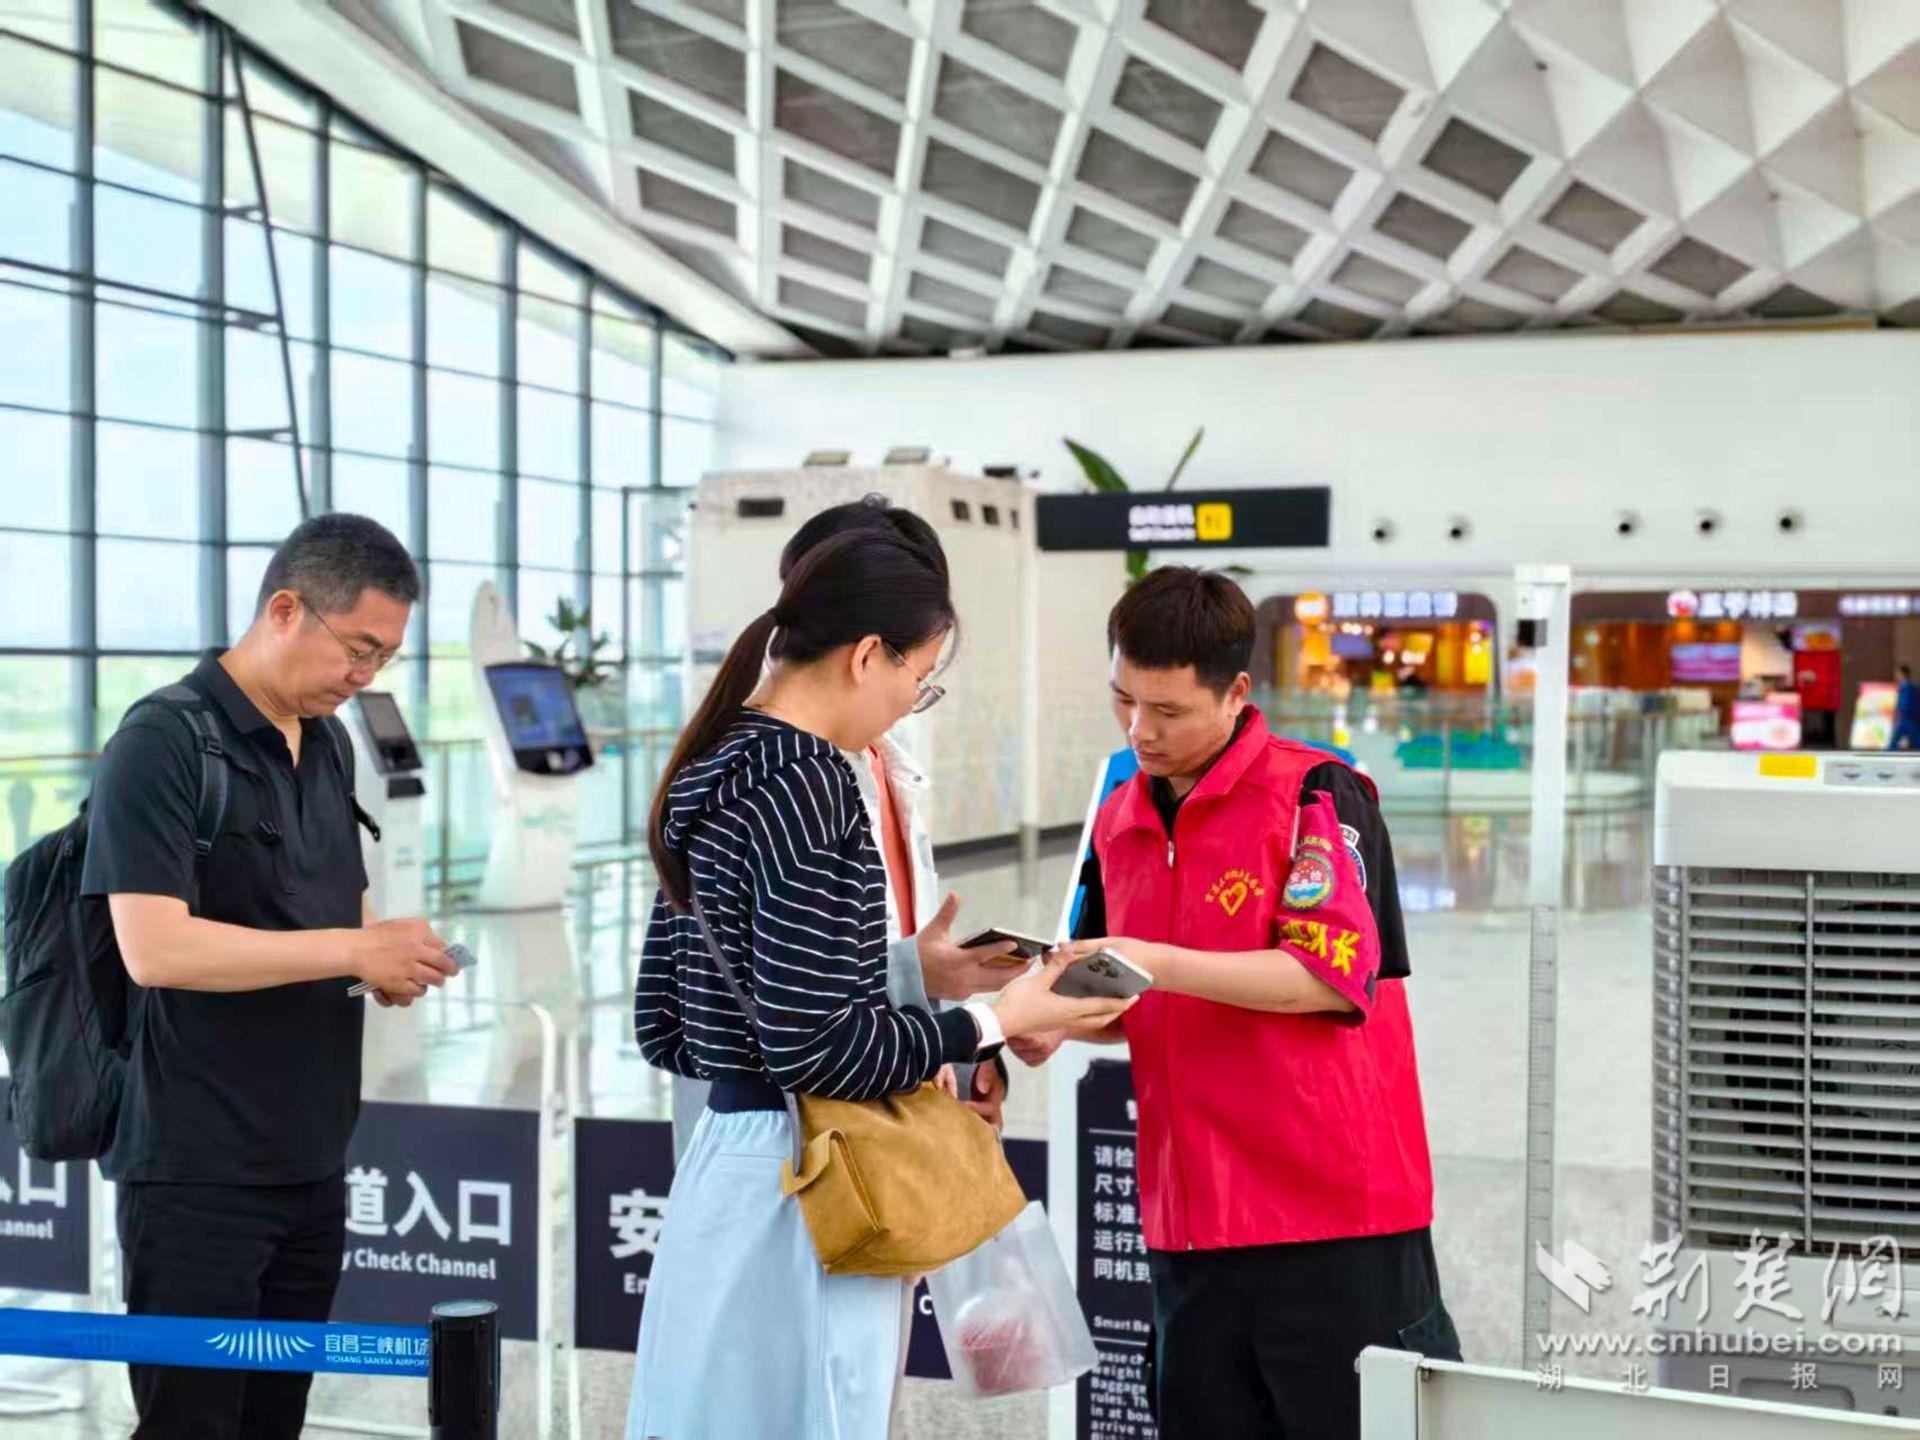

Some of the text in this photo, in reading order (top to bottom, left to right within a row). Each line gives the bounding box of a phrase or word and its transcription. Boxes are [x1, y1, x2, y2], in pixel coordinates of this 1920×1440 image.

[354, 1249, 413, 1273] Check
[415, 1253, 496, 1281] Channel
[1094, 1315, 1131, 1332] Smart
[325, 1334, 430, 1356] 宜昌三峡机场
[326, 1355, 362, 1364] YICHANG
[364, 1355, 393, 1365] SANXIA
[1091, 1376, 1147, 1396] Baggage
[1126, 1407, 1154, 1423] boa
